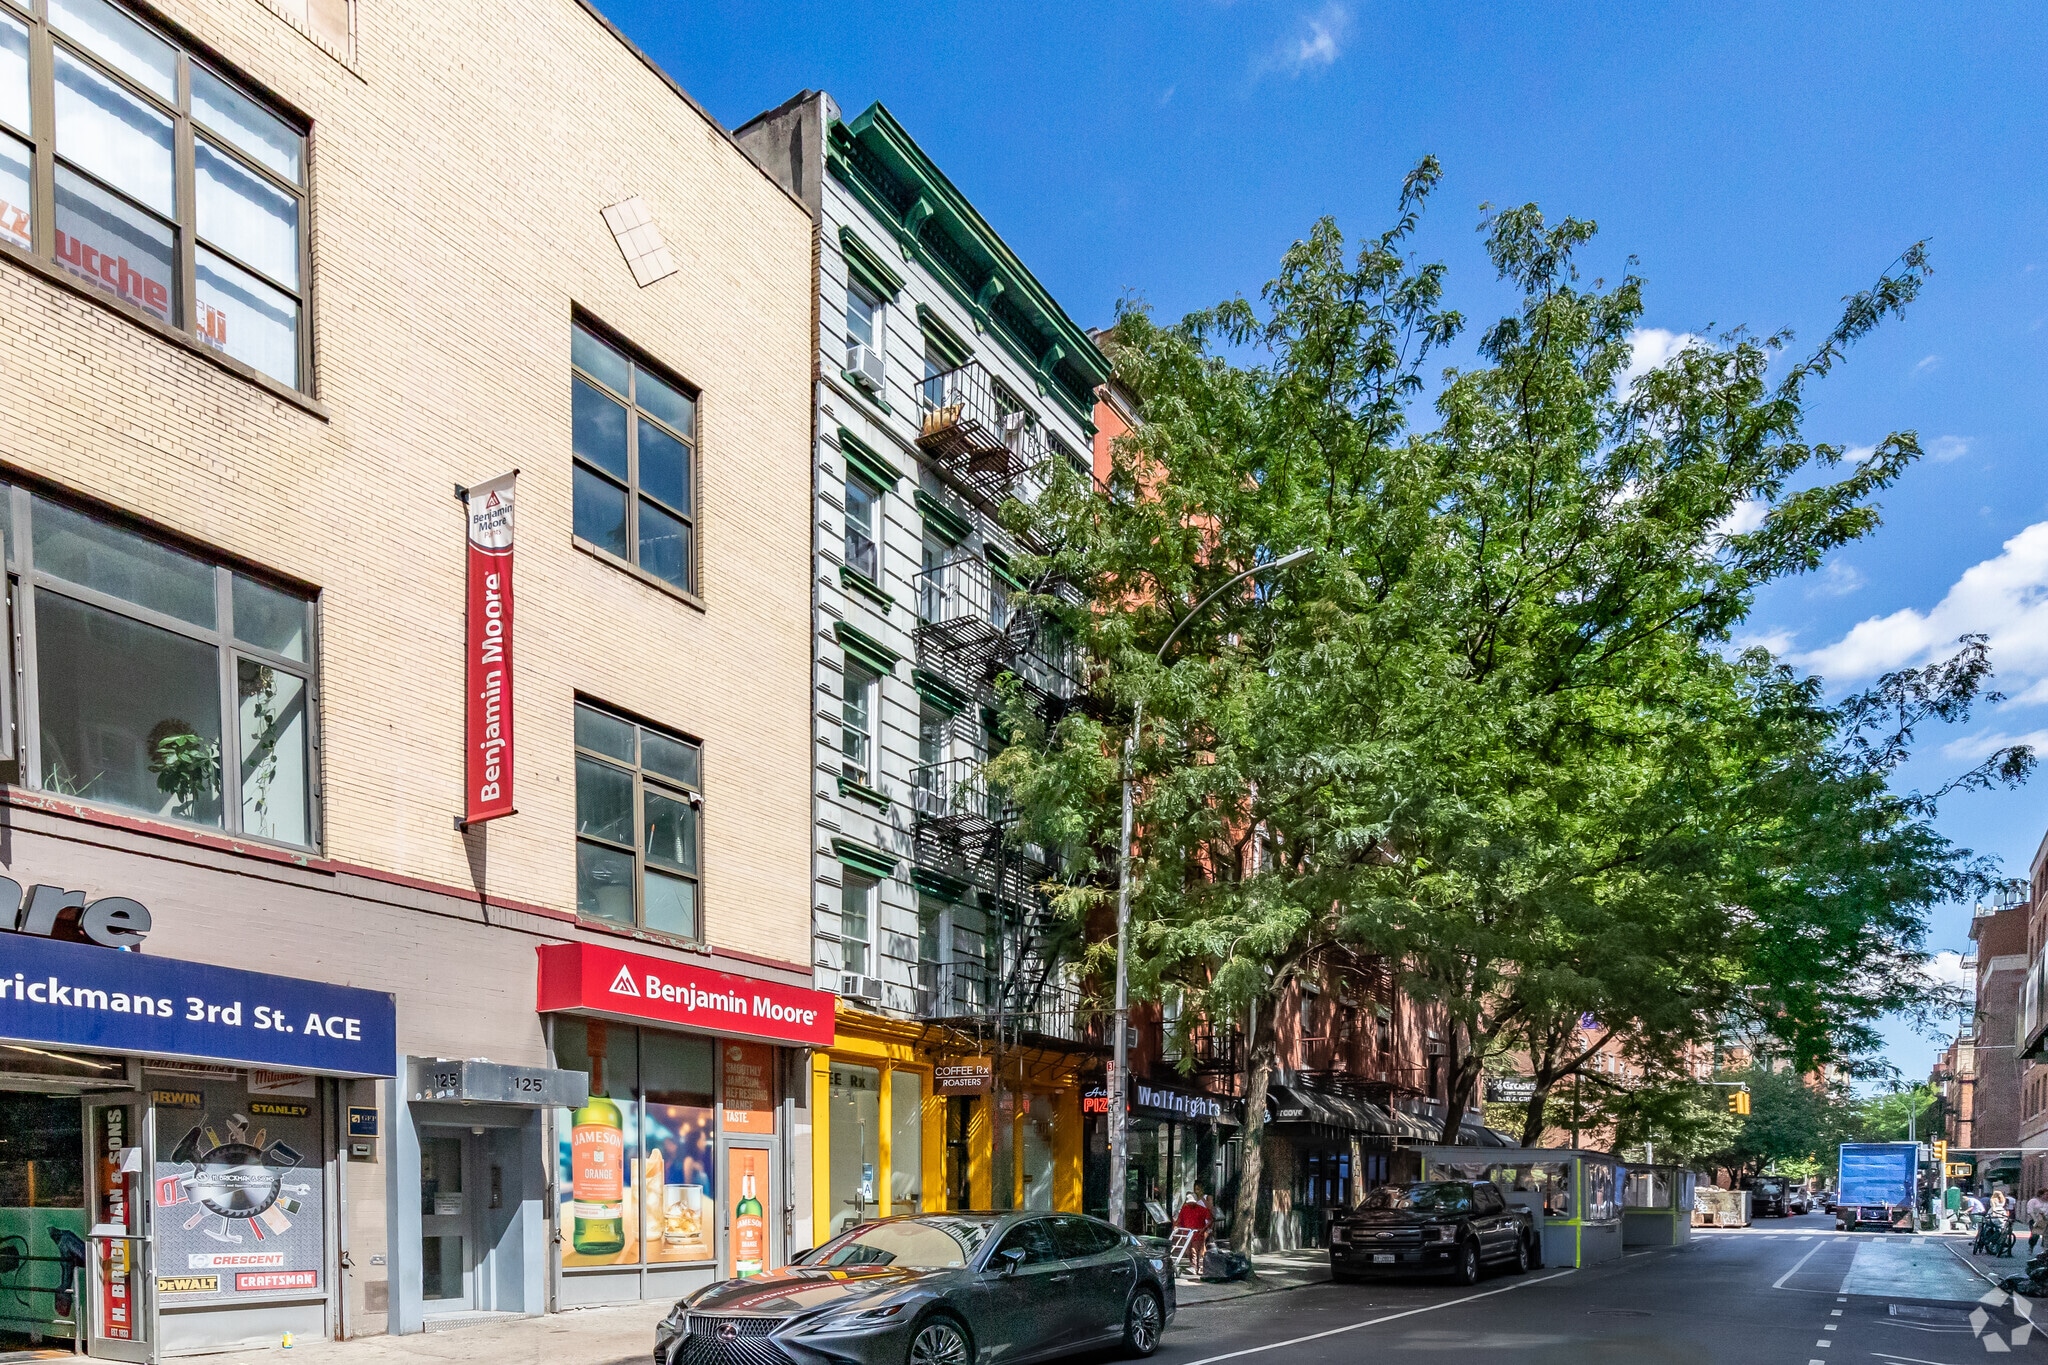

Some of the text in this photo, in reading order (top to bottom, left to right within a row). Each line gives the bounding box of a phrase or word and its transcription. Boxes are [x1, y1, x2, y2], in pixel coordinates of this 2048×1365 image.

[474, 504, 513, 524] Benjamin
[479, 517, 507, 532] Moore
[480, 670, 506, 802] Benjamin
[646, 975, 747, 1015] Benjamin
[186, 998, 241, 1026] 3rd
[254, 1006, 294, 1033] St.
[304, 1013, 361, 1041] ACE
[726, 1062, 762, 1076] SMOOTHLY
[935, 1065, 989, 1076] COFFEE Rx
[434, 1073, 457, 1089] 125
[515, 1077, 543, 1092] 125
[850, 1075, 865, 1088] Rx
[943, 1079, 981, 1087] ROASTERS
[153, 1091, 200, 1104] IRWIN
[726, 1086, 768, 1101] REFRESHING
[726, 1099, 753, 1111] ORANGE
[1138, 1085, 1221, 1118] Wolfnights
[252, 1103, 307, 1116] STANLEY
[726, 1111, 749, 1123] TASTE.
[108, 1109, 122, 1164] SONS
[574, 1131, 622, 1148] JAMESON
[111, 1169, 122, 1184] &
[584, 1168, 613, 1179] ORANGE
[864, 1183, 872, 1193] A
[213, 1254, 283, 1265] CRESCENT
[241, 1274, 312, 1287] CRAFTSMAN
[112, 1303, 126, 1322] H.
